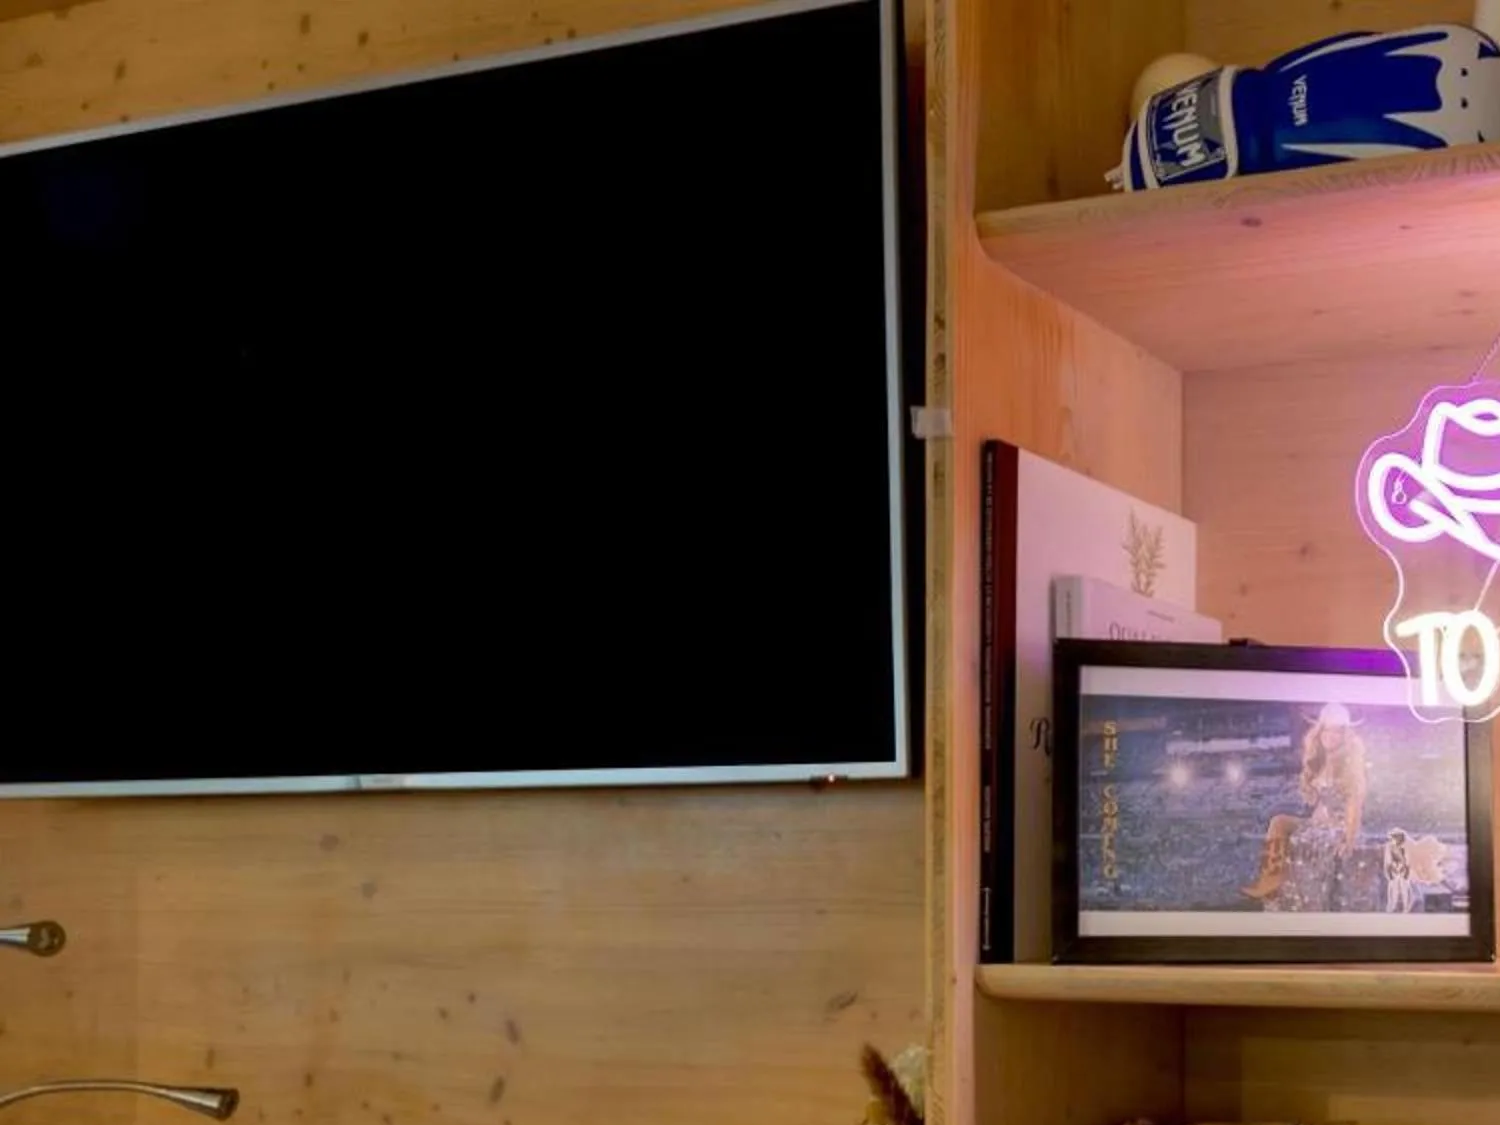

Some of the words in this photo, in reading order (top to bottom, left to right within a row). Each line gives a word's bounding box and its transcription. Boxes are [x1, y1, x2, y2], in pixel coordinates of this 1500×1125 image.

[1162, 81, 1206, 167] VENUM
[1289, 74, 1308, 126] VENUM
[1396, 609, 1500, 706] TO
